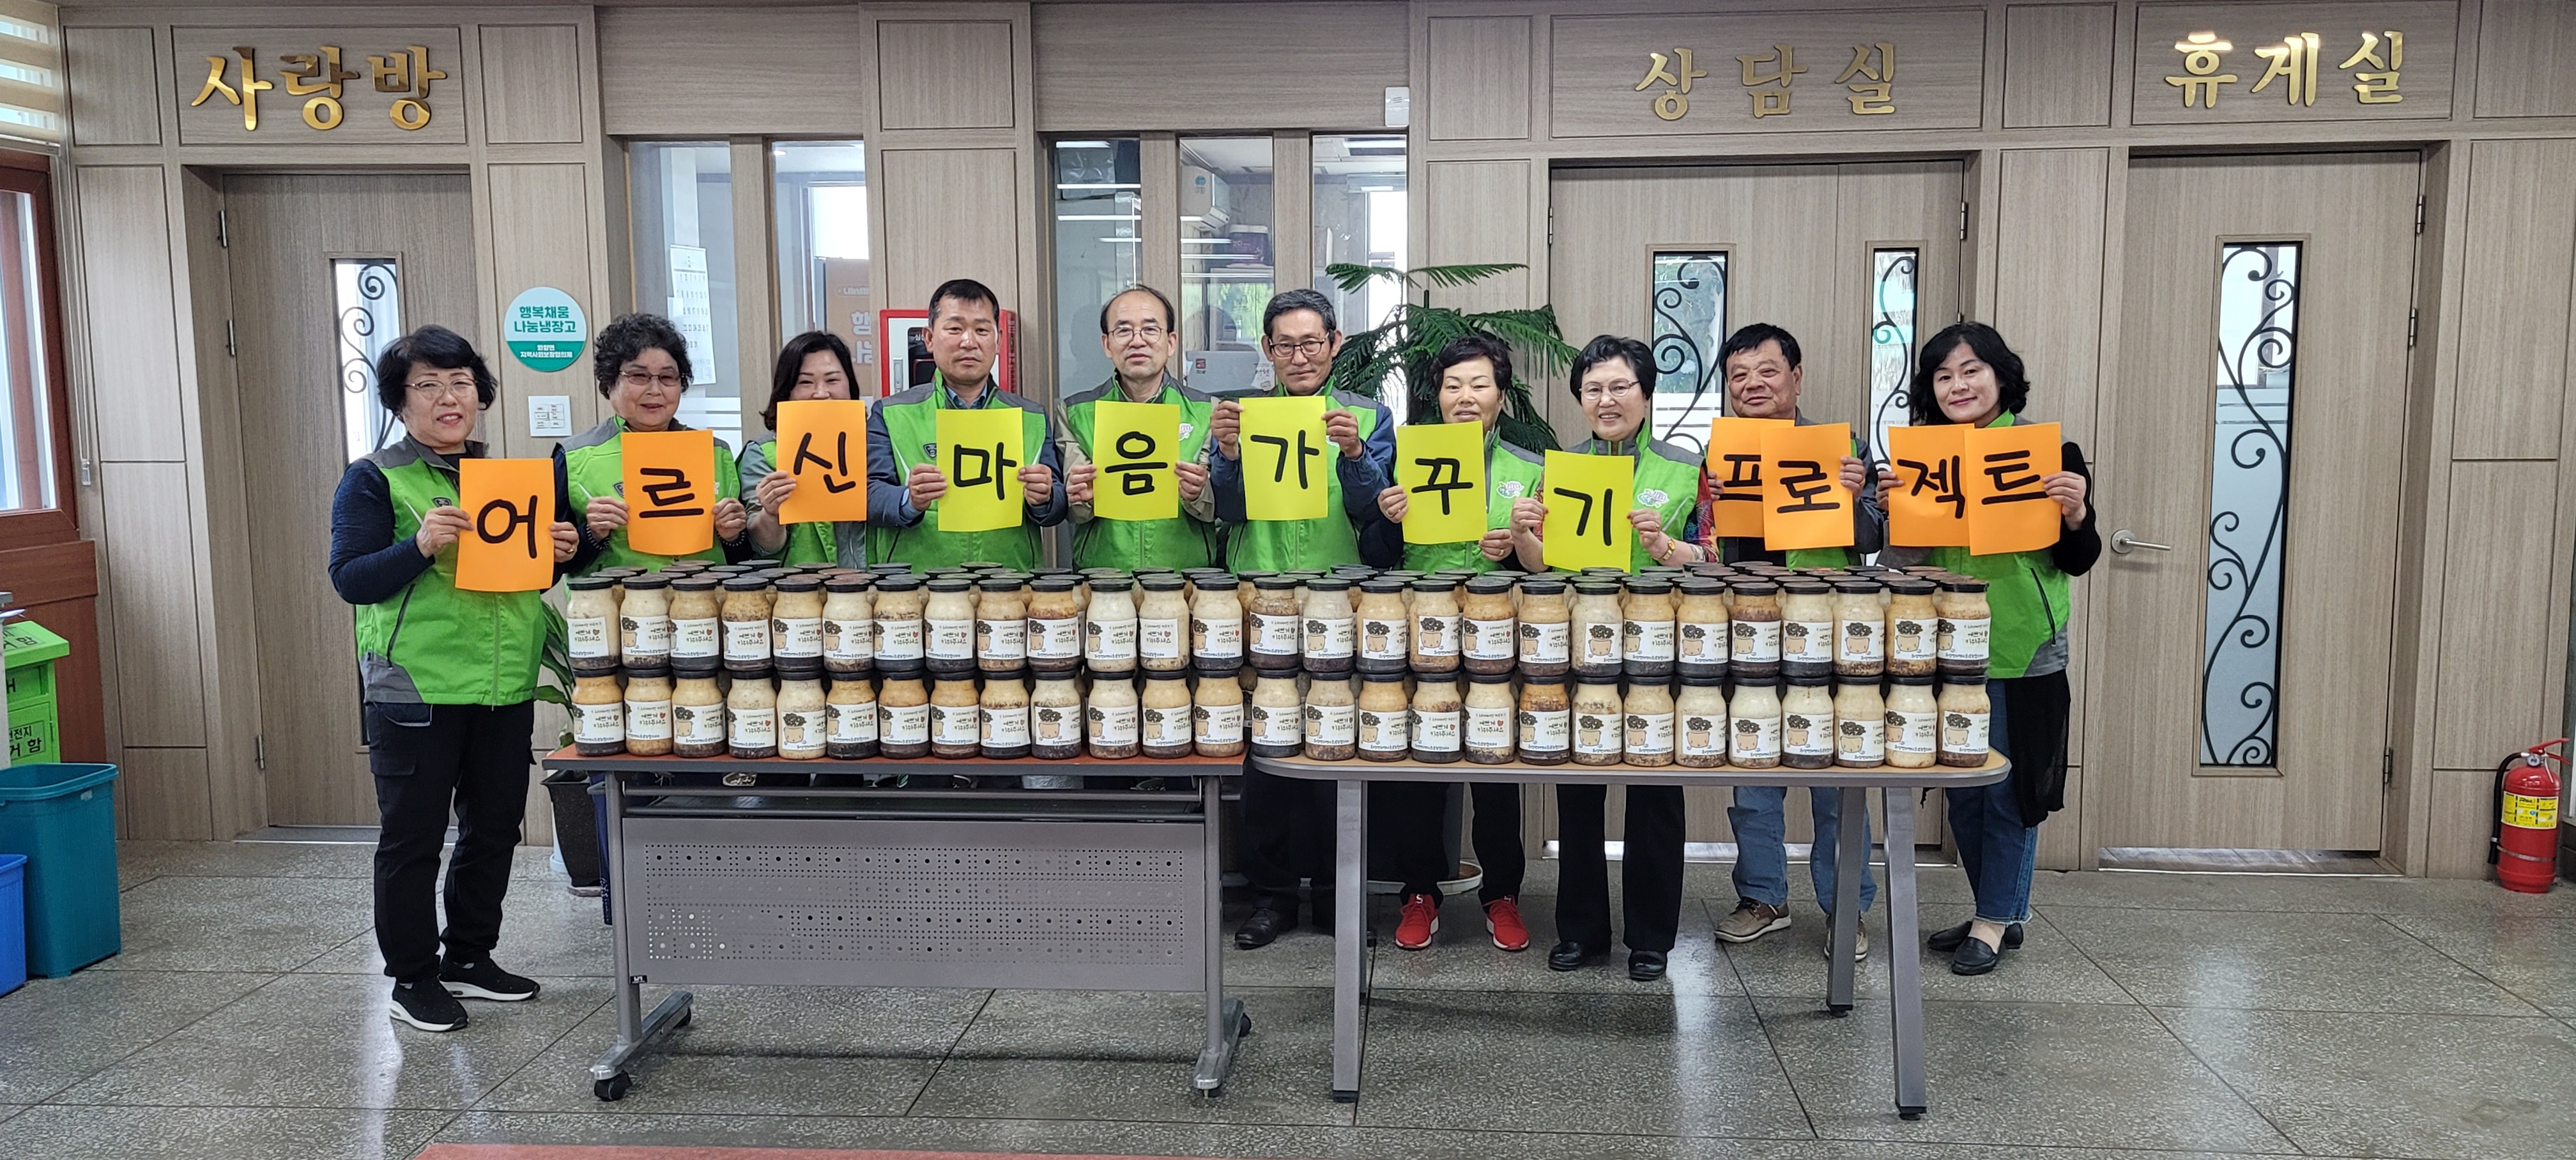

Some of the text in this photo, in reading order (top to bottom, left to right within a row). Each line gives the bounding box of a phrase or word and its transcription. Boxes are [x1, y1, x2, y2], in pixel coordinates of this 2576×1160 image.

[191, 45, 448, 131] 사랑방
[1635, 42, 1897, 120] 상담실
[2165, 31, 2405, 109] 휴게실
[514, 321, 577, 333] 나눔냉장고
[519, 307, 569, 318] 행복채움
[793, 432, 855, 493] 신
[954, 443, 1016, 500] 마
[1105, 432, 1167, 495] 음
[1251, 431, 1319, 489] 가
[27, 738, 42, 753] 함
